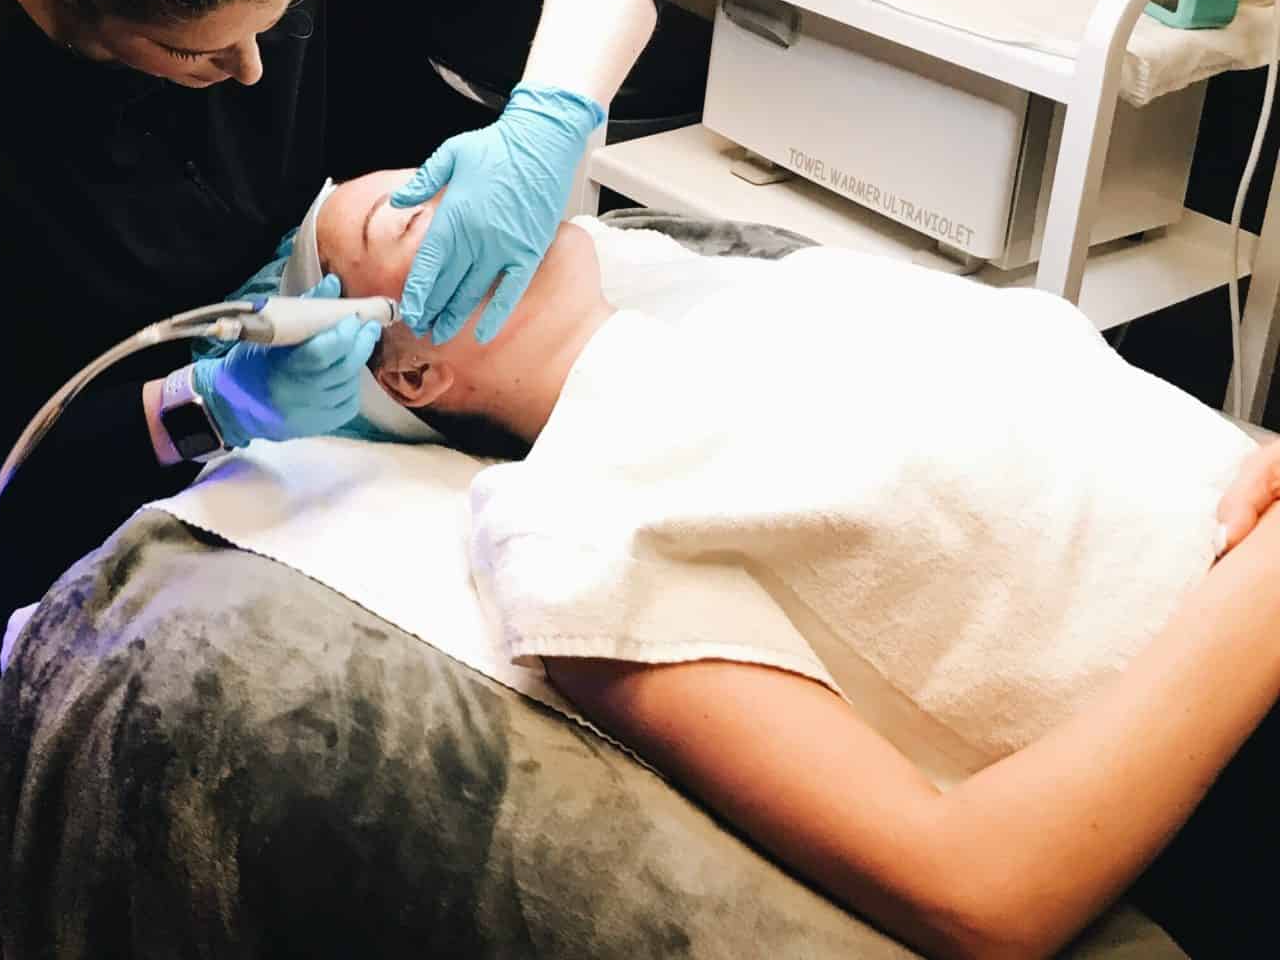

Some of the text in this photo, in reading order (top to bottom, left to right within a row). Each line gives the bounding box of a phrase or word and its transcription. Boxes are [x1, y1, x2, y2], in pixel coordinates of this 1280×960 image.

[788, 147, 975, 246] TOWEL WARMER ULTRAVIOLET
